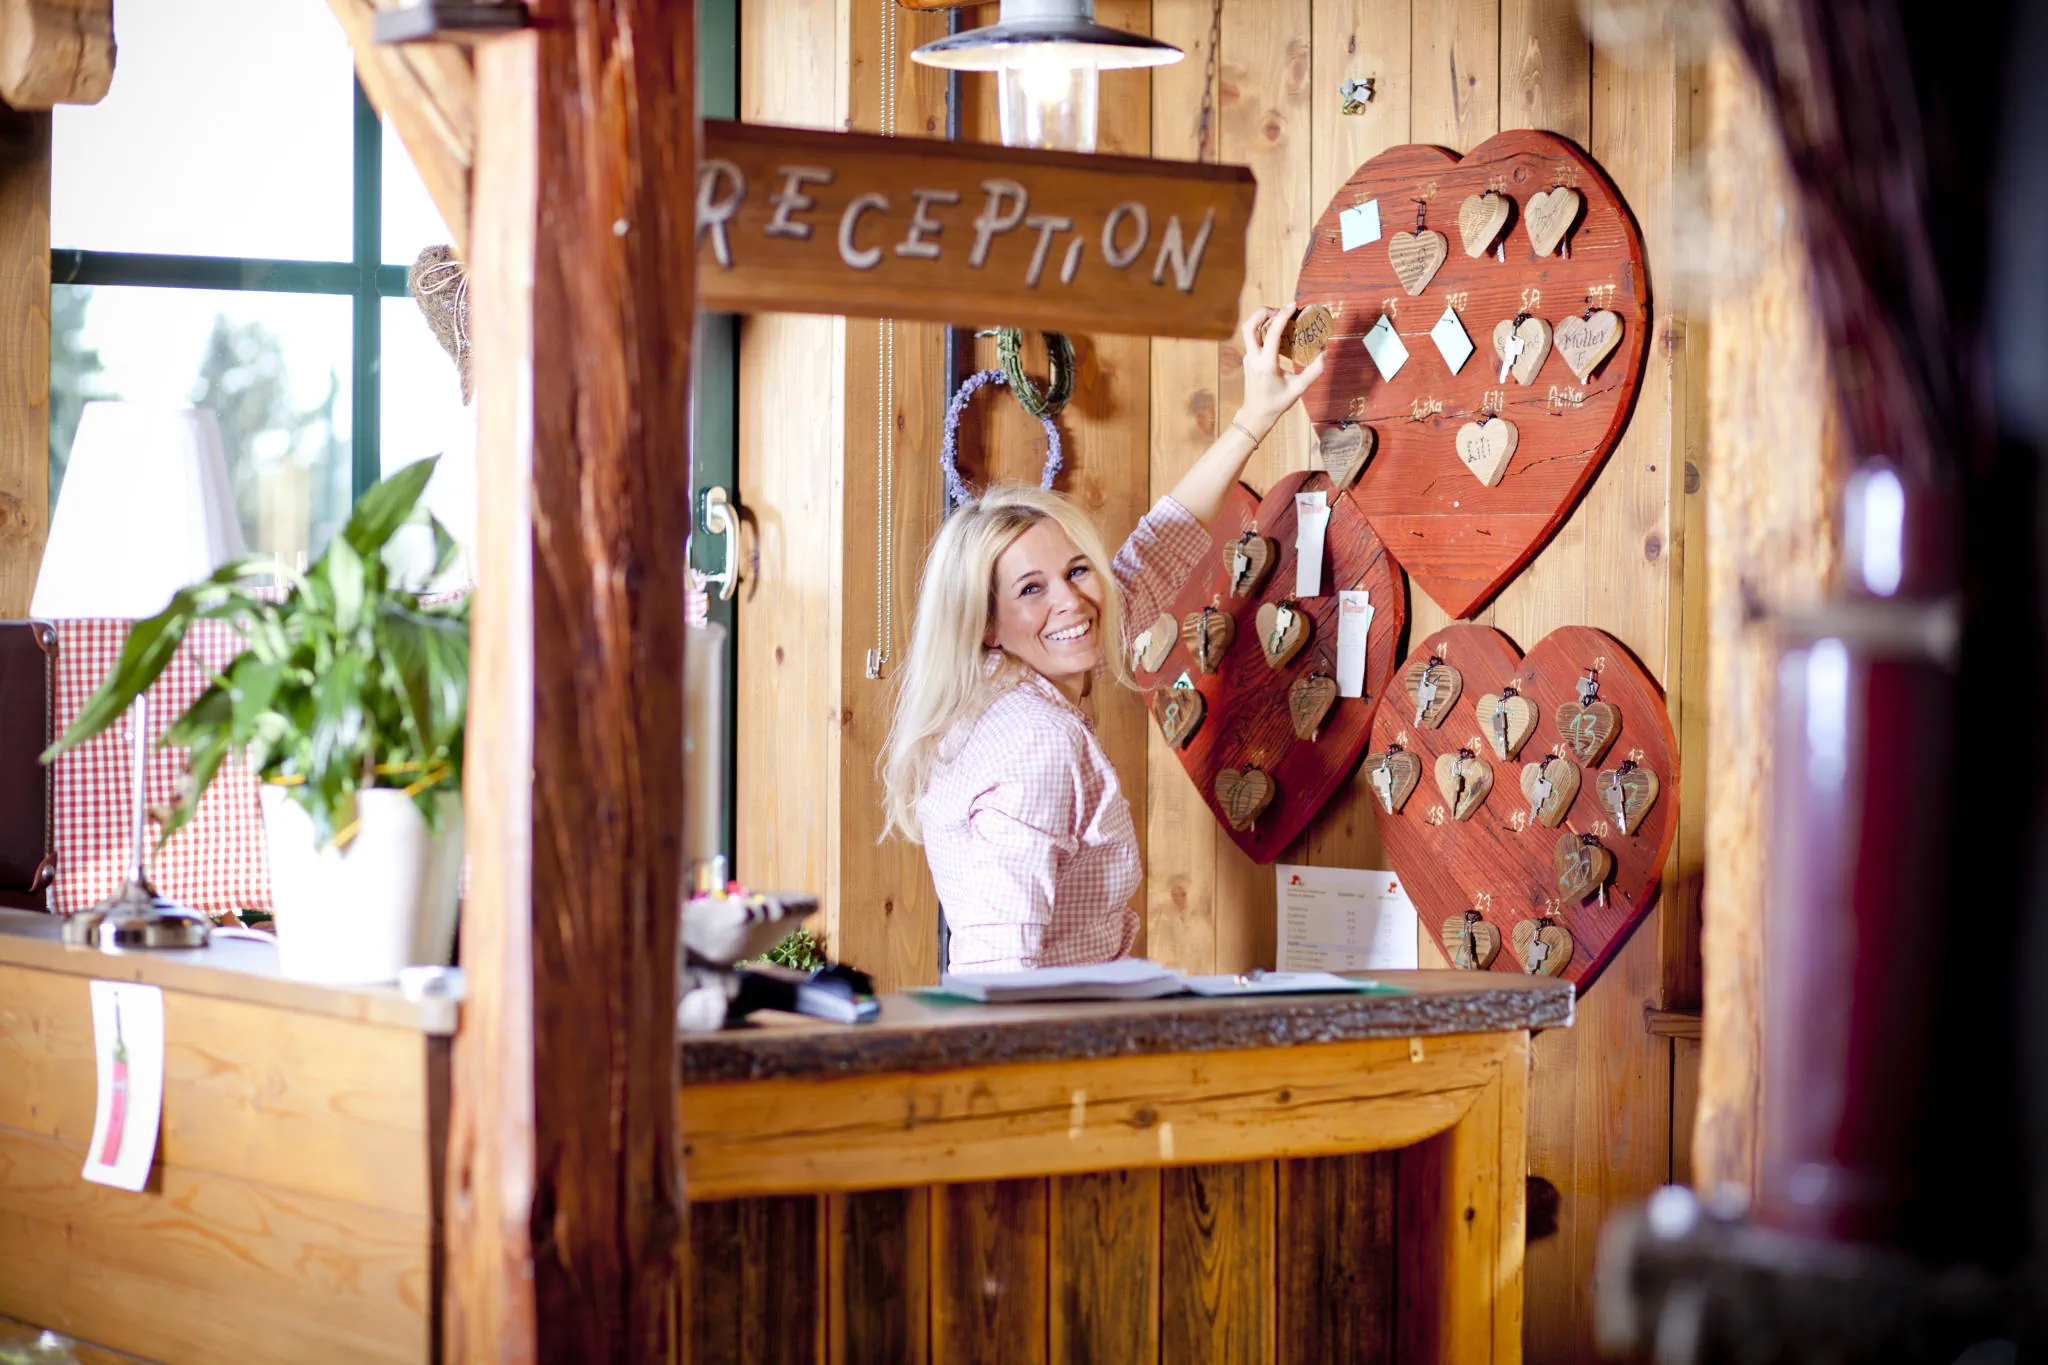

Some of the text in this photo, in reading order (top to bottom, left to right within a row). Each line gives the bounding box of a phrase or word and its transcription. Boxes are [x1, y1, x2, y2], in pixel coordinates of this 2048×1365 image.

[696, 159, 1215, 292] RECEPTION
[1520, 288, 1541, 313] SA
[1436, 642, 1448, 660] 11
[1594, 656, 1606, 673] 13
[1162, 703, 1180, 737] 8
[1569, 712, 1597, 755] 13
[1552, 743, 1566, 761] 16
[1226, 782, 1253, 818] 10
[1428, 805, 1445, 826] 18
[1510, 810, 1526, 833] 19
[1591, 820, 1608, 838] 20
[1560, 852, 1592, 889] 20
[1474, 891, 1492, 912] 21
[1544, 898, 1561, 916] 22
